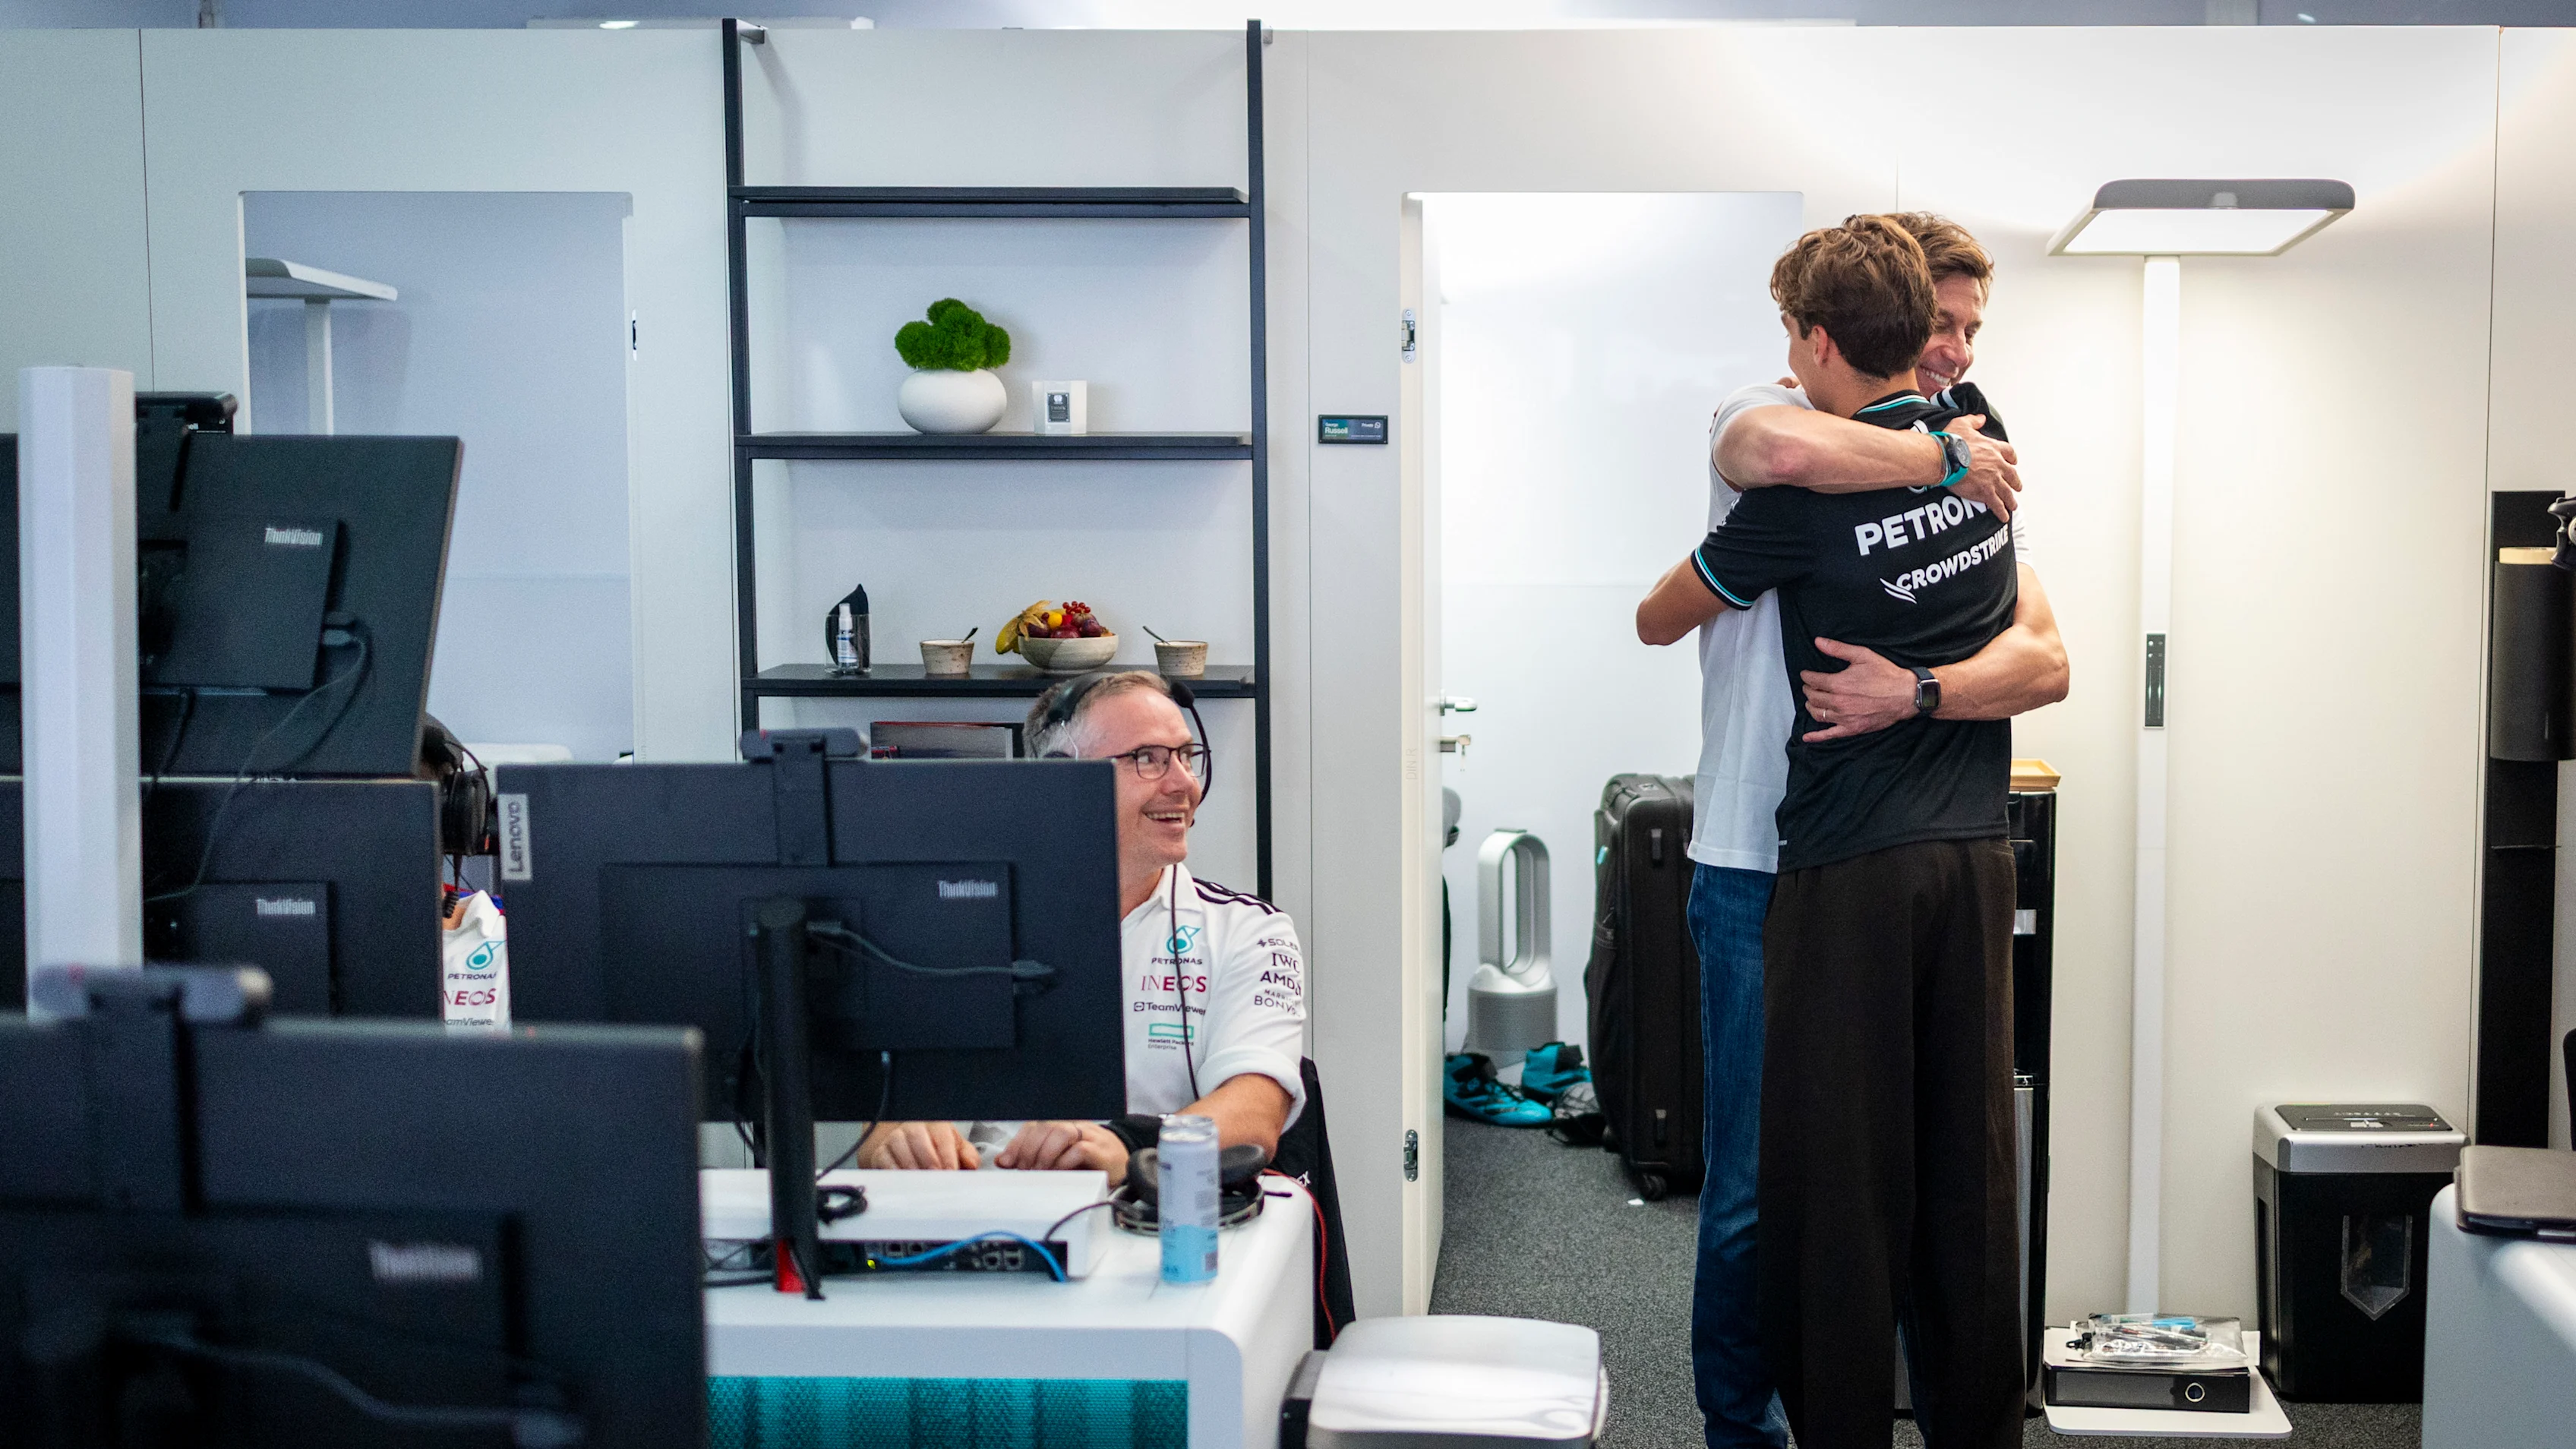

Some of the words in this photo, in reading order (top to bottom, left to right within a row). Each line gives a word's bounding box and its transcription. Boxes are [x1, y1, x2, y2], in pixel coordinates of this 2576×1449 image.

[1854, 495, 1988, 556] PETRON
[264, 528, 323, 545] ThinkVision
[1896, 523, 2009, 591] CROWDSTRIKE
[507, 802, 525, 873] Lenovo
[937, 879, 998, 898] ThinkVision
[1272, 952, 1300, 974] IWC
[1140, 974, 1207, 993] INEOS
[1259, 971, 1296, 990] AMD
[444, 988, 497, 1006] NEOS
[1146, 1002, 1206, 1016] TeamVewer
[446, 1018, 494, 1026] amViewe
